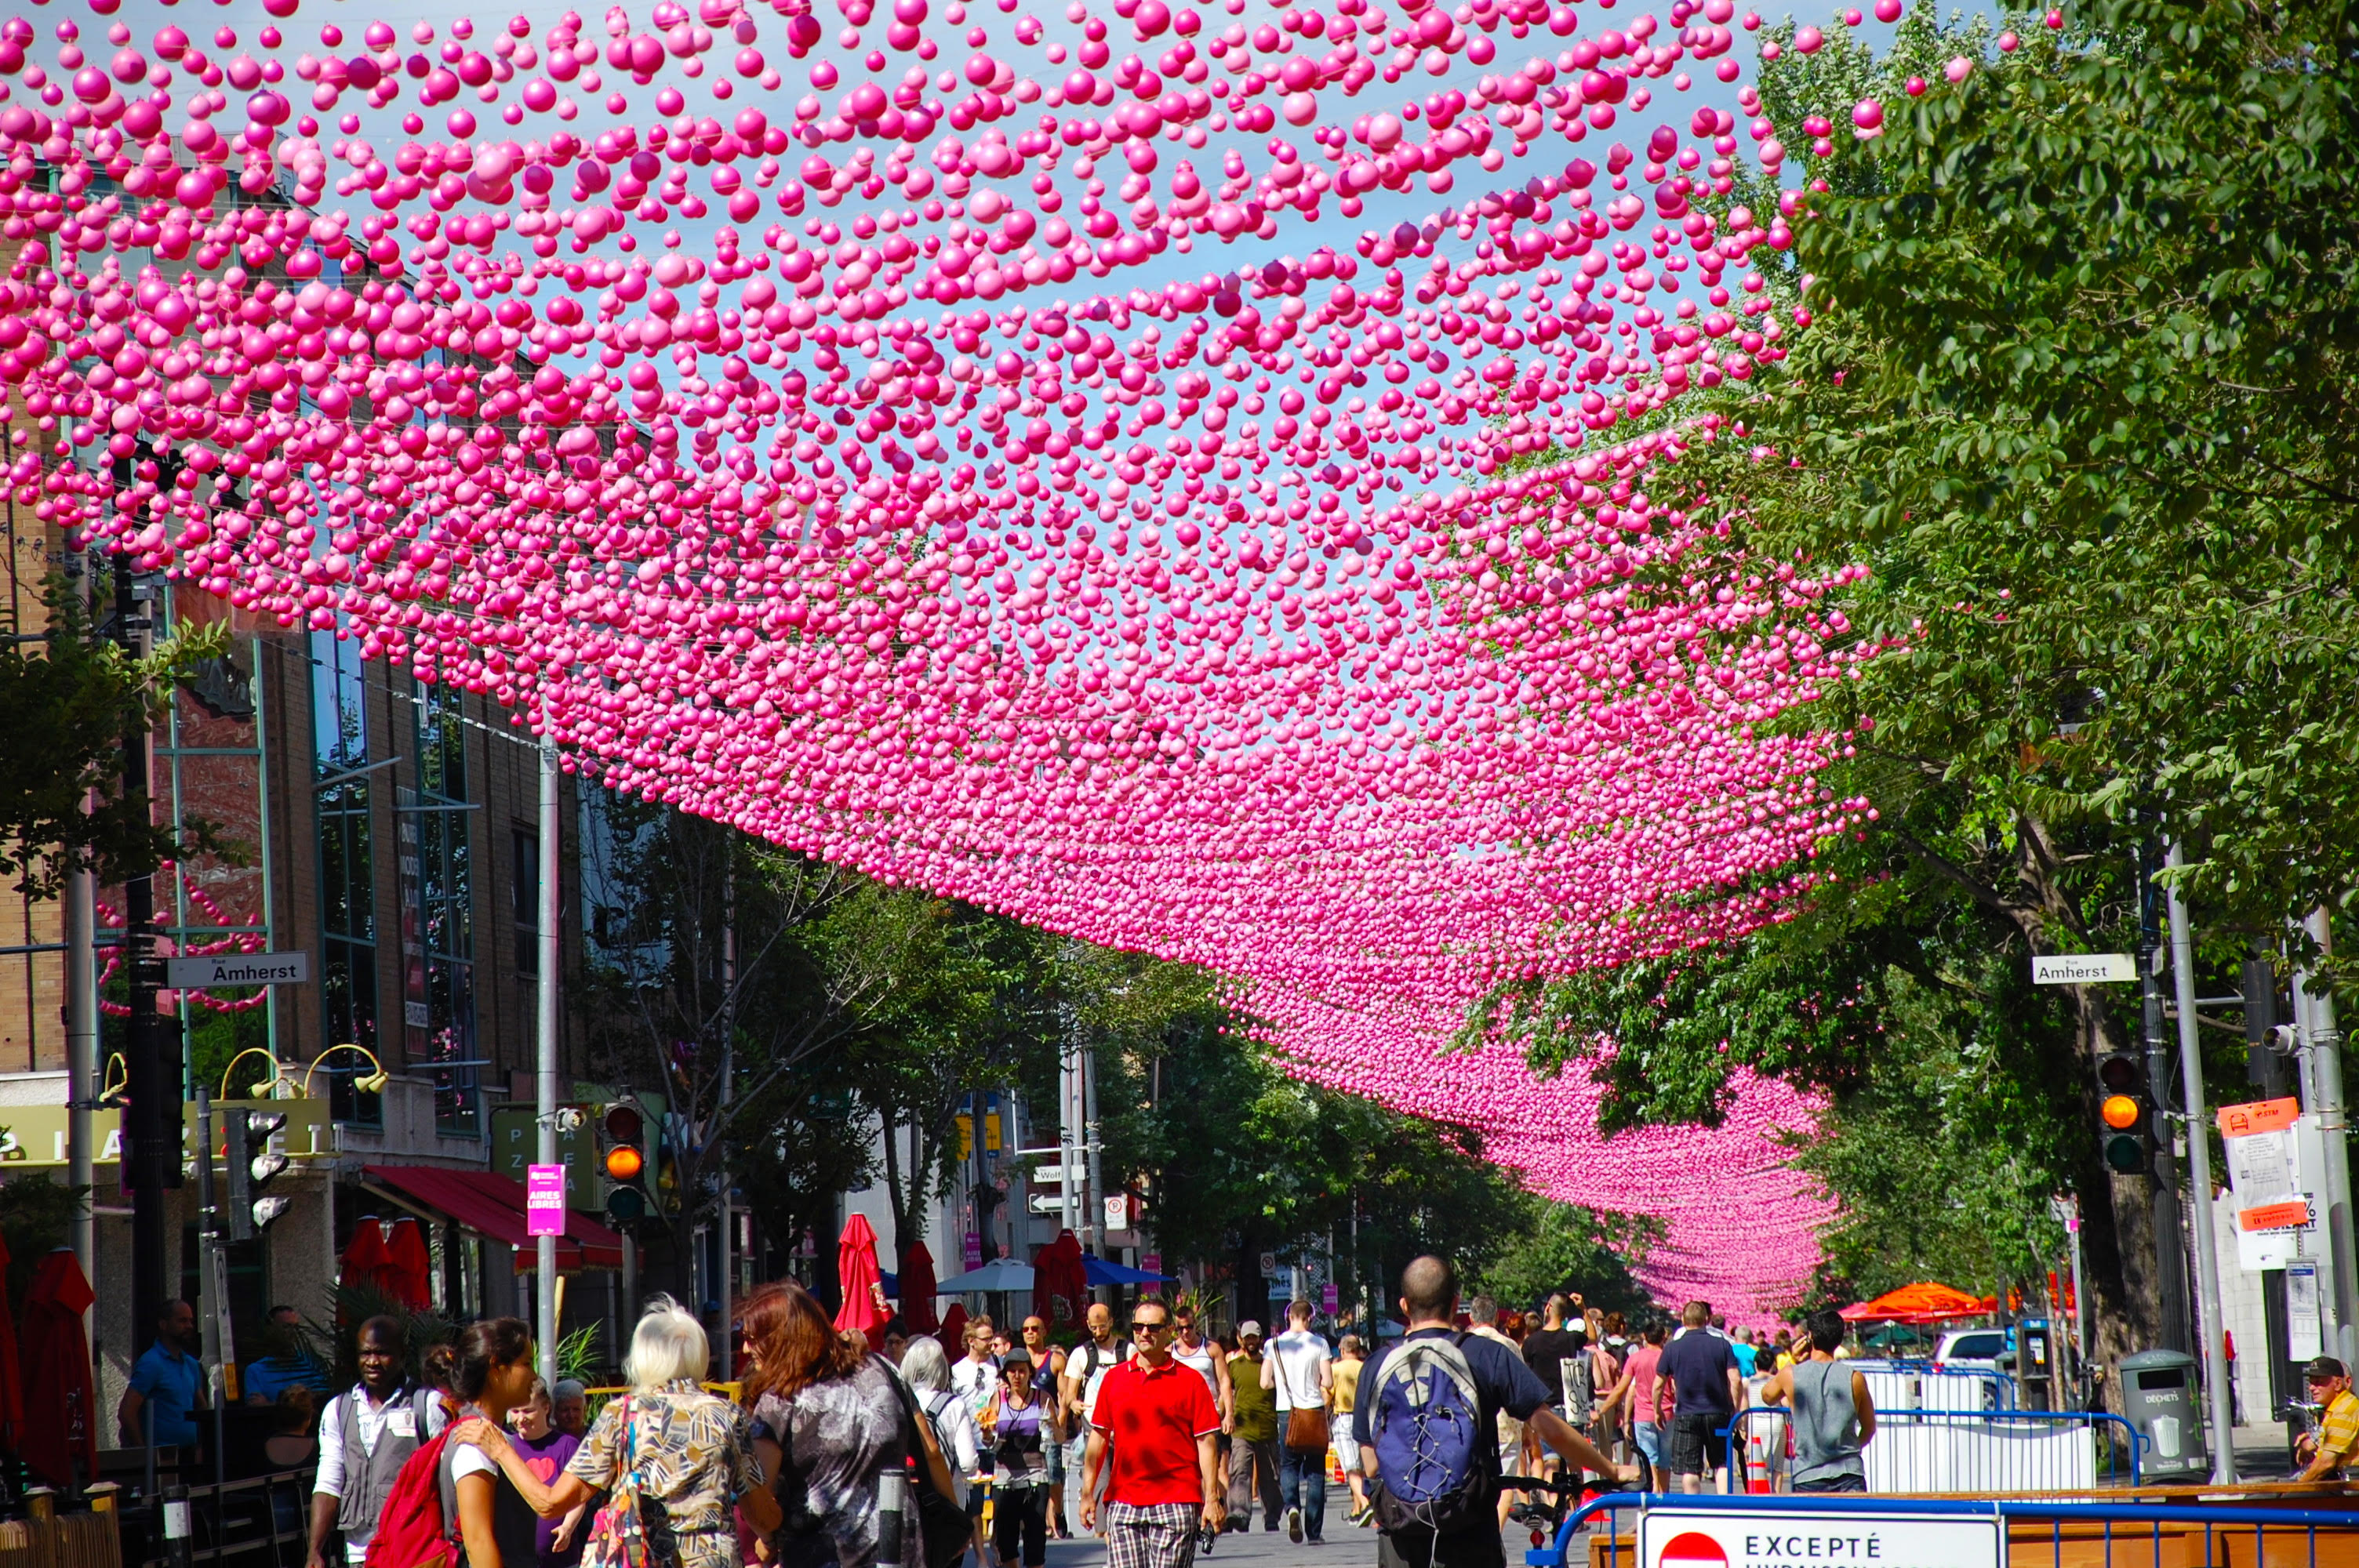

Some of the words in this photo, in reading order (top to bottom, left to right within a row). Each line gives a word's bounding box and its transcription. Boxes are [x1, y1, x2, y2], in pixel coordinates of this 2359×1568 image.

[213, 964, 296, 982] Amherst
[2039, 965, 2107, 979] Amherst
[529, 1191, 561, 1200] AIRES
[527, 1200, 562, 1209] LIBRES
[1745, 1532, 1881, 1559] EXCEPTÉ
